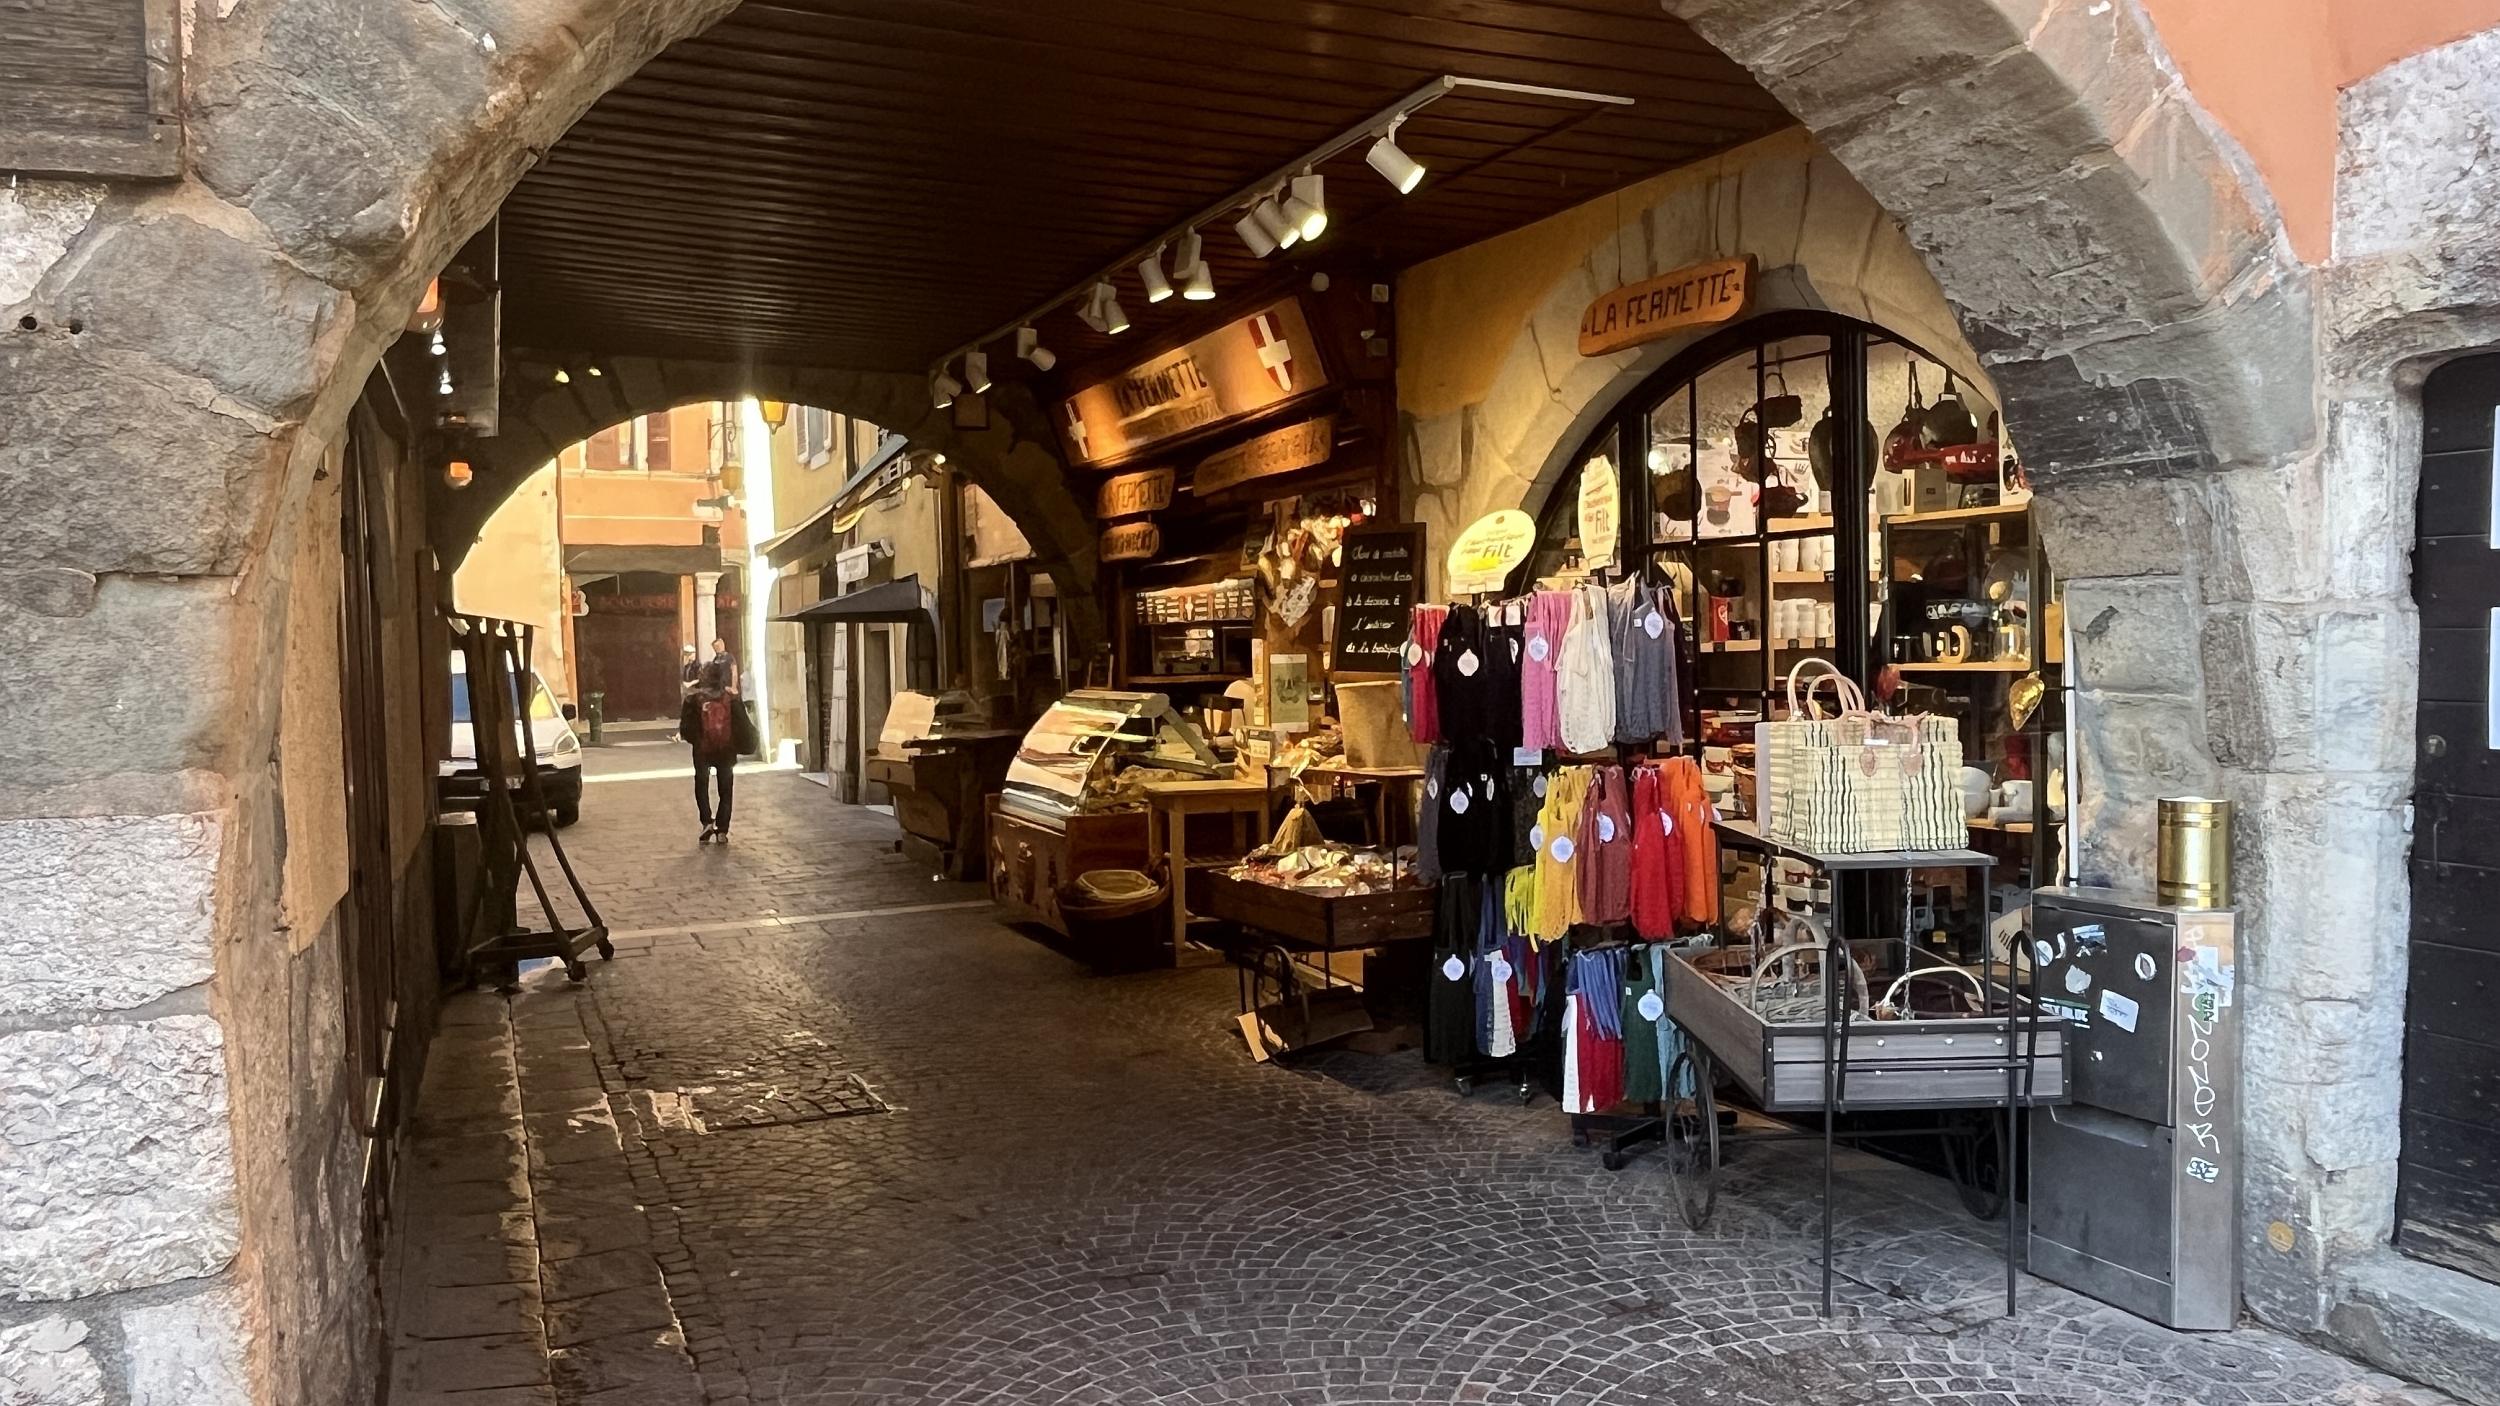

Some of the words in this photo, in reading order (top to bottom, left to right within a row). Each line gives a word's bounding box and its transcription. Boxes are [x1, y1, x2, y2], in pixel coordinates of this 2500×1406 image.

[1591, 302, 1617, 336] LA
[1625, 268, 1737, 328] FERMETTE
[1482, 543, 1513, 559] Filt
